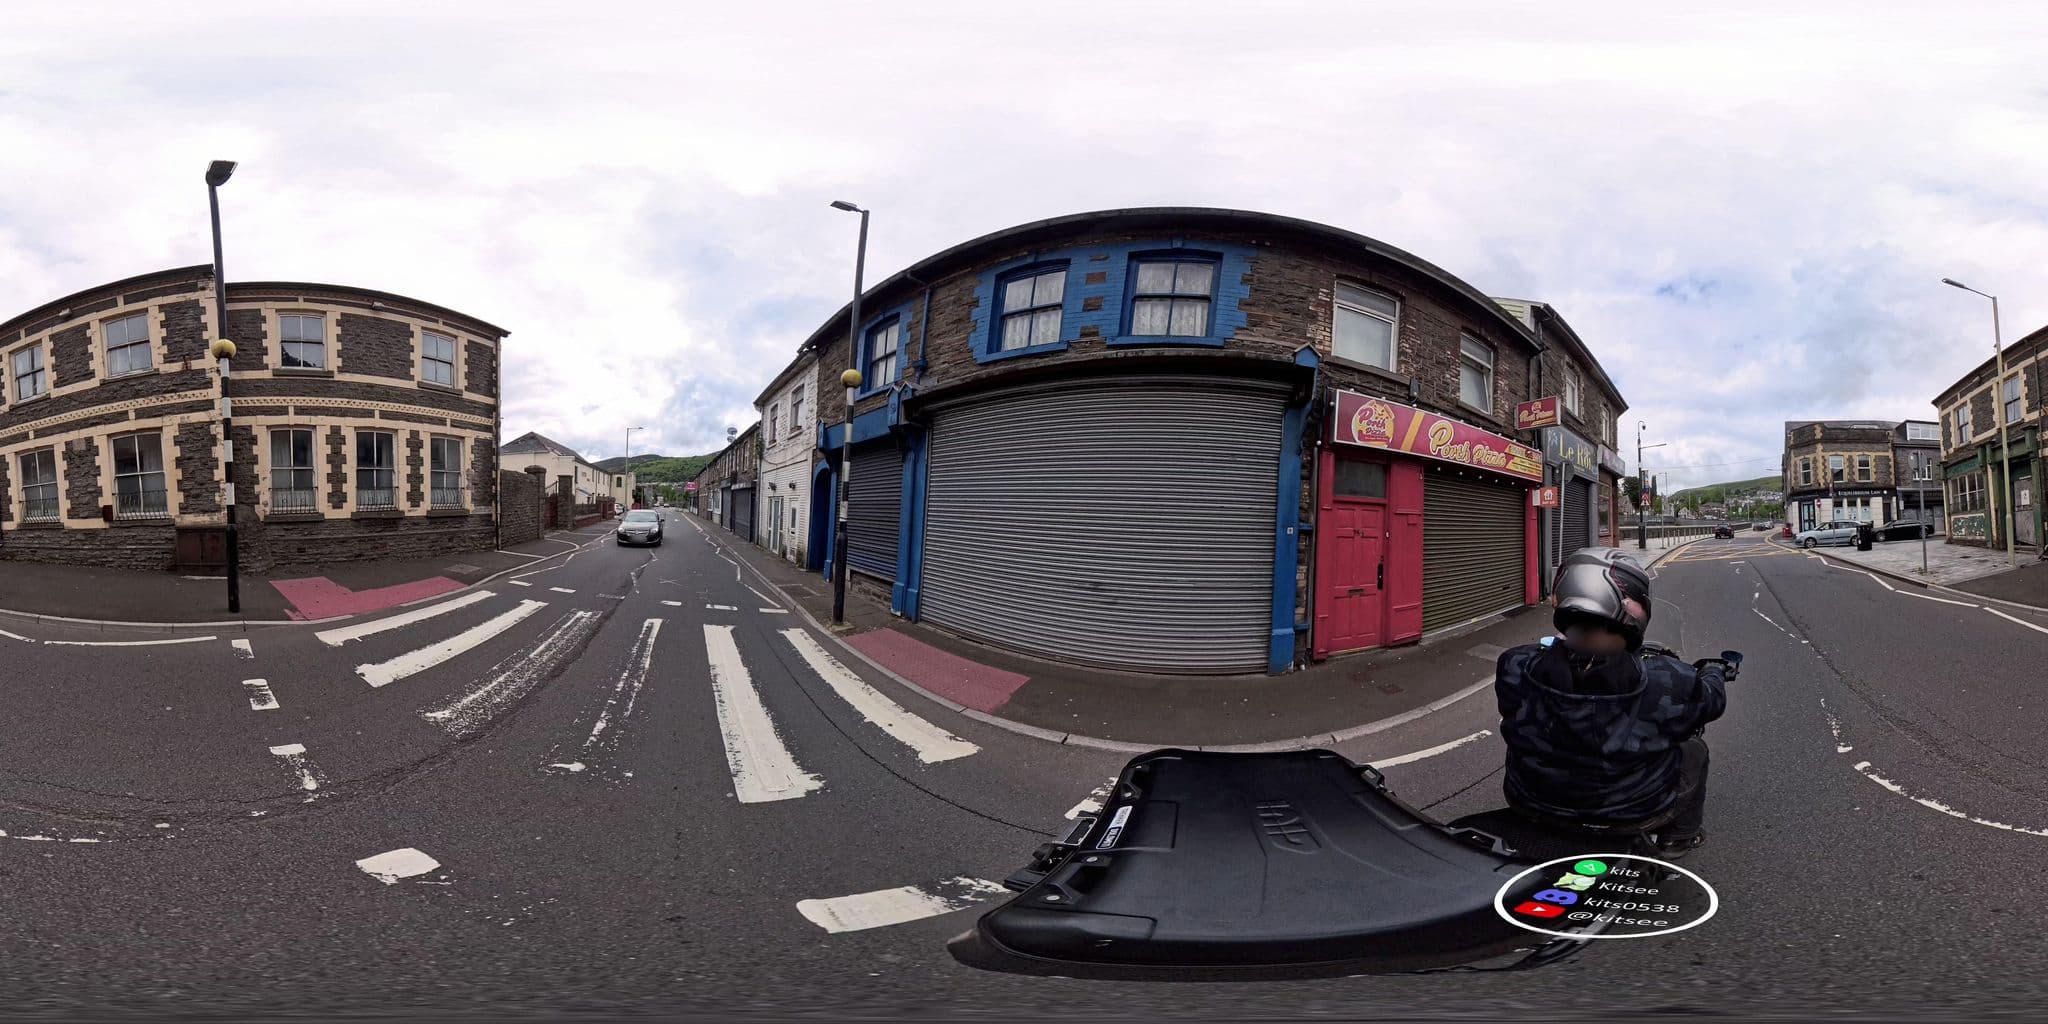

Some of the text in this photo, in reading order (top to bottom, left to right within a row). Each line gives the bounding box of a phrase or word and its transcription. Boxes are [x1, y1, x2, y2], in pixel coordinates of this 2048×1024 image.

[1358, 407, 1386, 430] Porth
[1428, 419, 1471, 465] Porth
[1473, 444, 1507, 468] Pizza
[1559, 432, 1575, 460] Le
